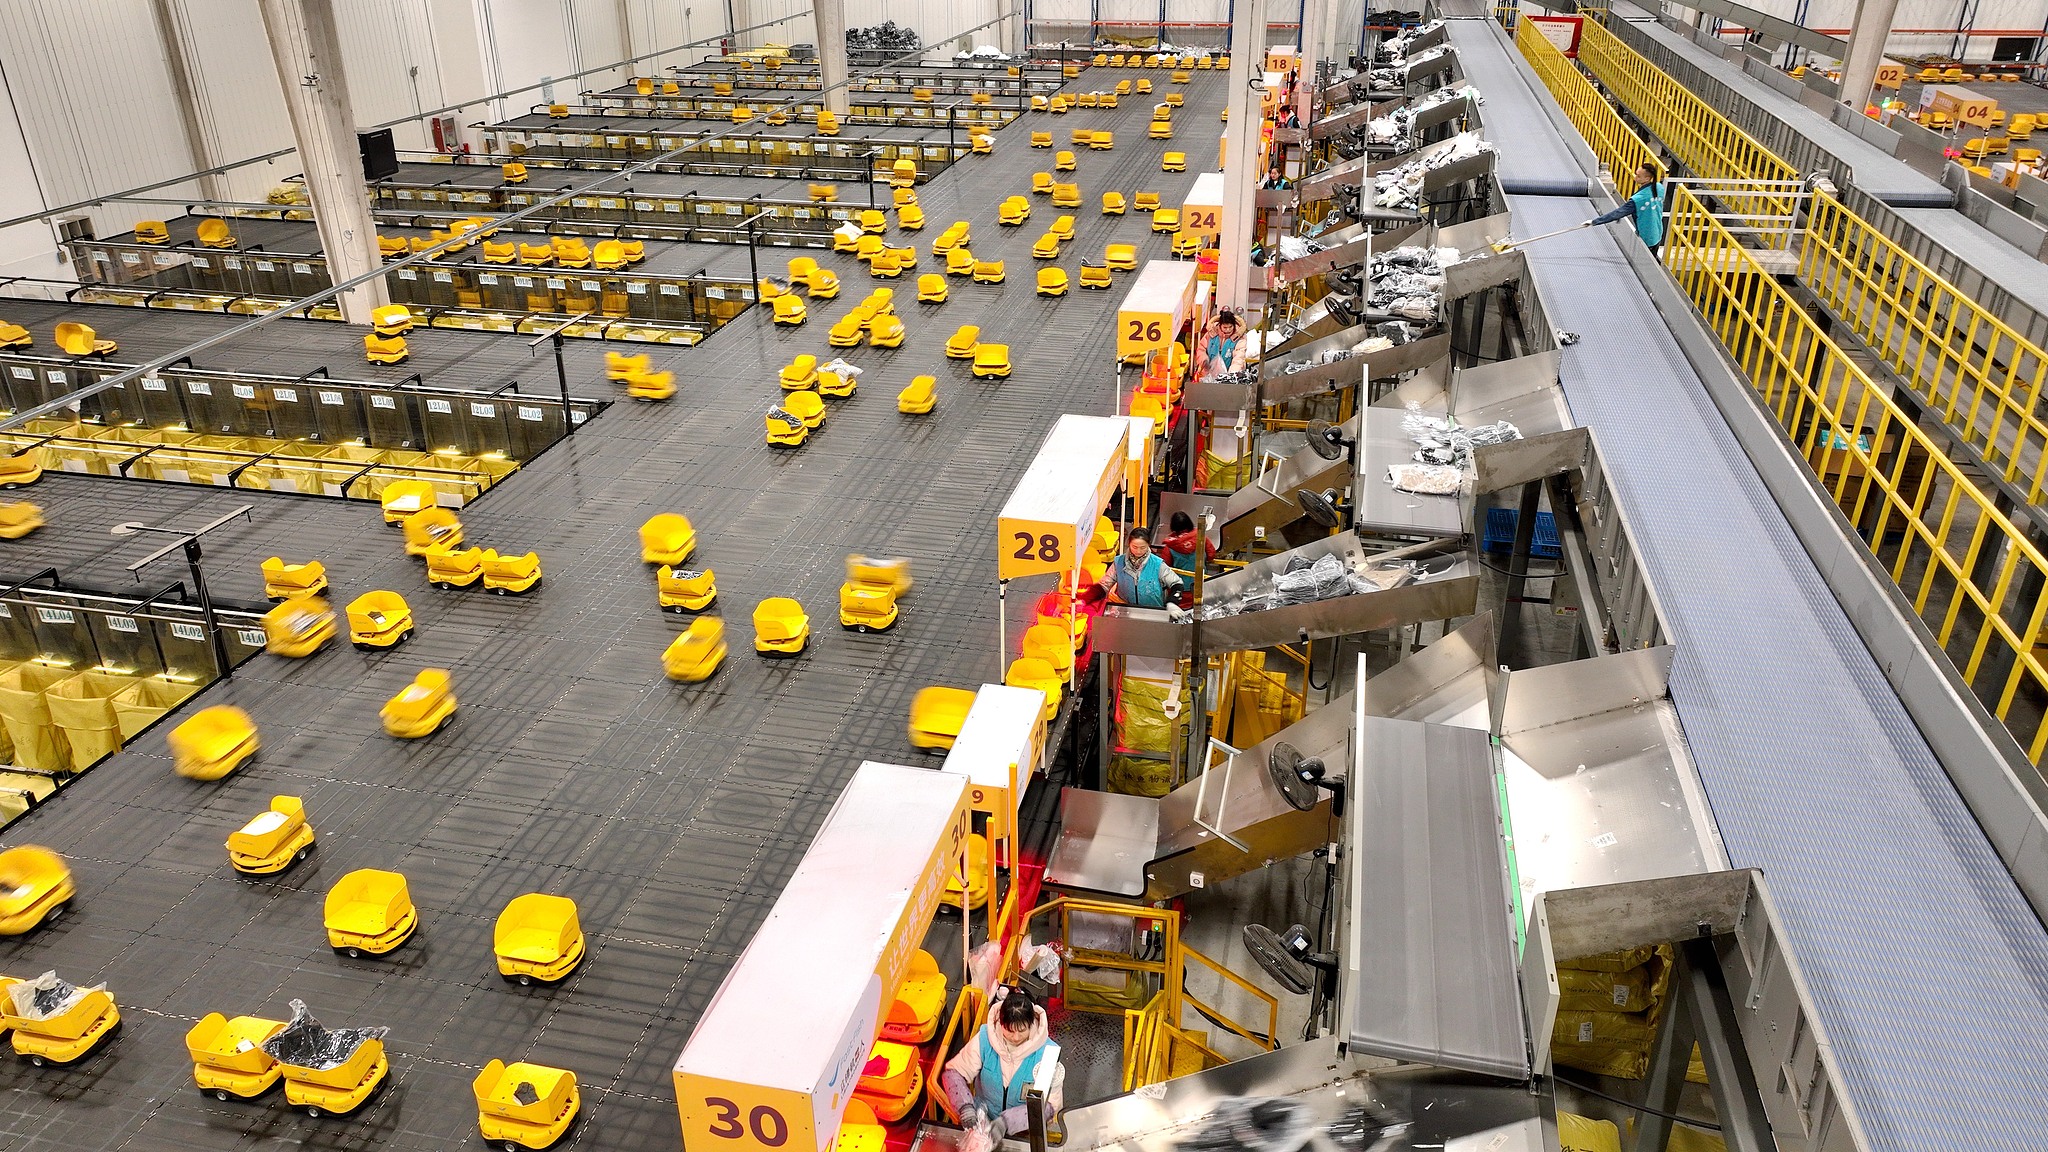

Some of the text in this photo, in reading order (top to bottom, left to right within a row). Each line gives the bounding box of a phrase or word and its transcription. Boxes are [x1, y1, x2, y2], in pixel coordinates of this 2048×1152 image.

[1272, 59, 1287, 70] 18
[1879, 70, 1898, 82] 02
[1966, 106, 1988, 119] 04
[1189, 211, 1216, 229] 24
[1128, 320, 1162, 342] 26
[143, 379, 166, 390] 12L10
[275, 390, 296, 401] 12L07
[429, 401, 450, 413] 12L04
[472, 404, 494, 416] 12L03
[519, 407, 541, 419] 12L02
[1013, 532, 1061, 563] 28
[39, 609, 73, 621] 14L04
[108, 616, 136, 630] 14L03
[172, 624, 203, 639] 14L02
[240, 631, 265, 645] 14L0
[1034, 720, 1044, 756] 29
[951, 809, 967, 858] 30
[704, 1097, 788, 1148] 30
